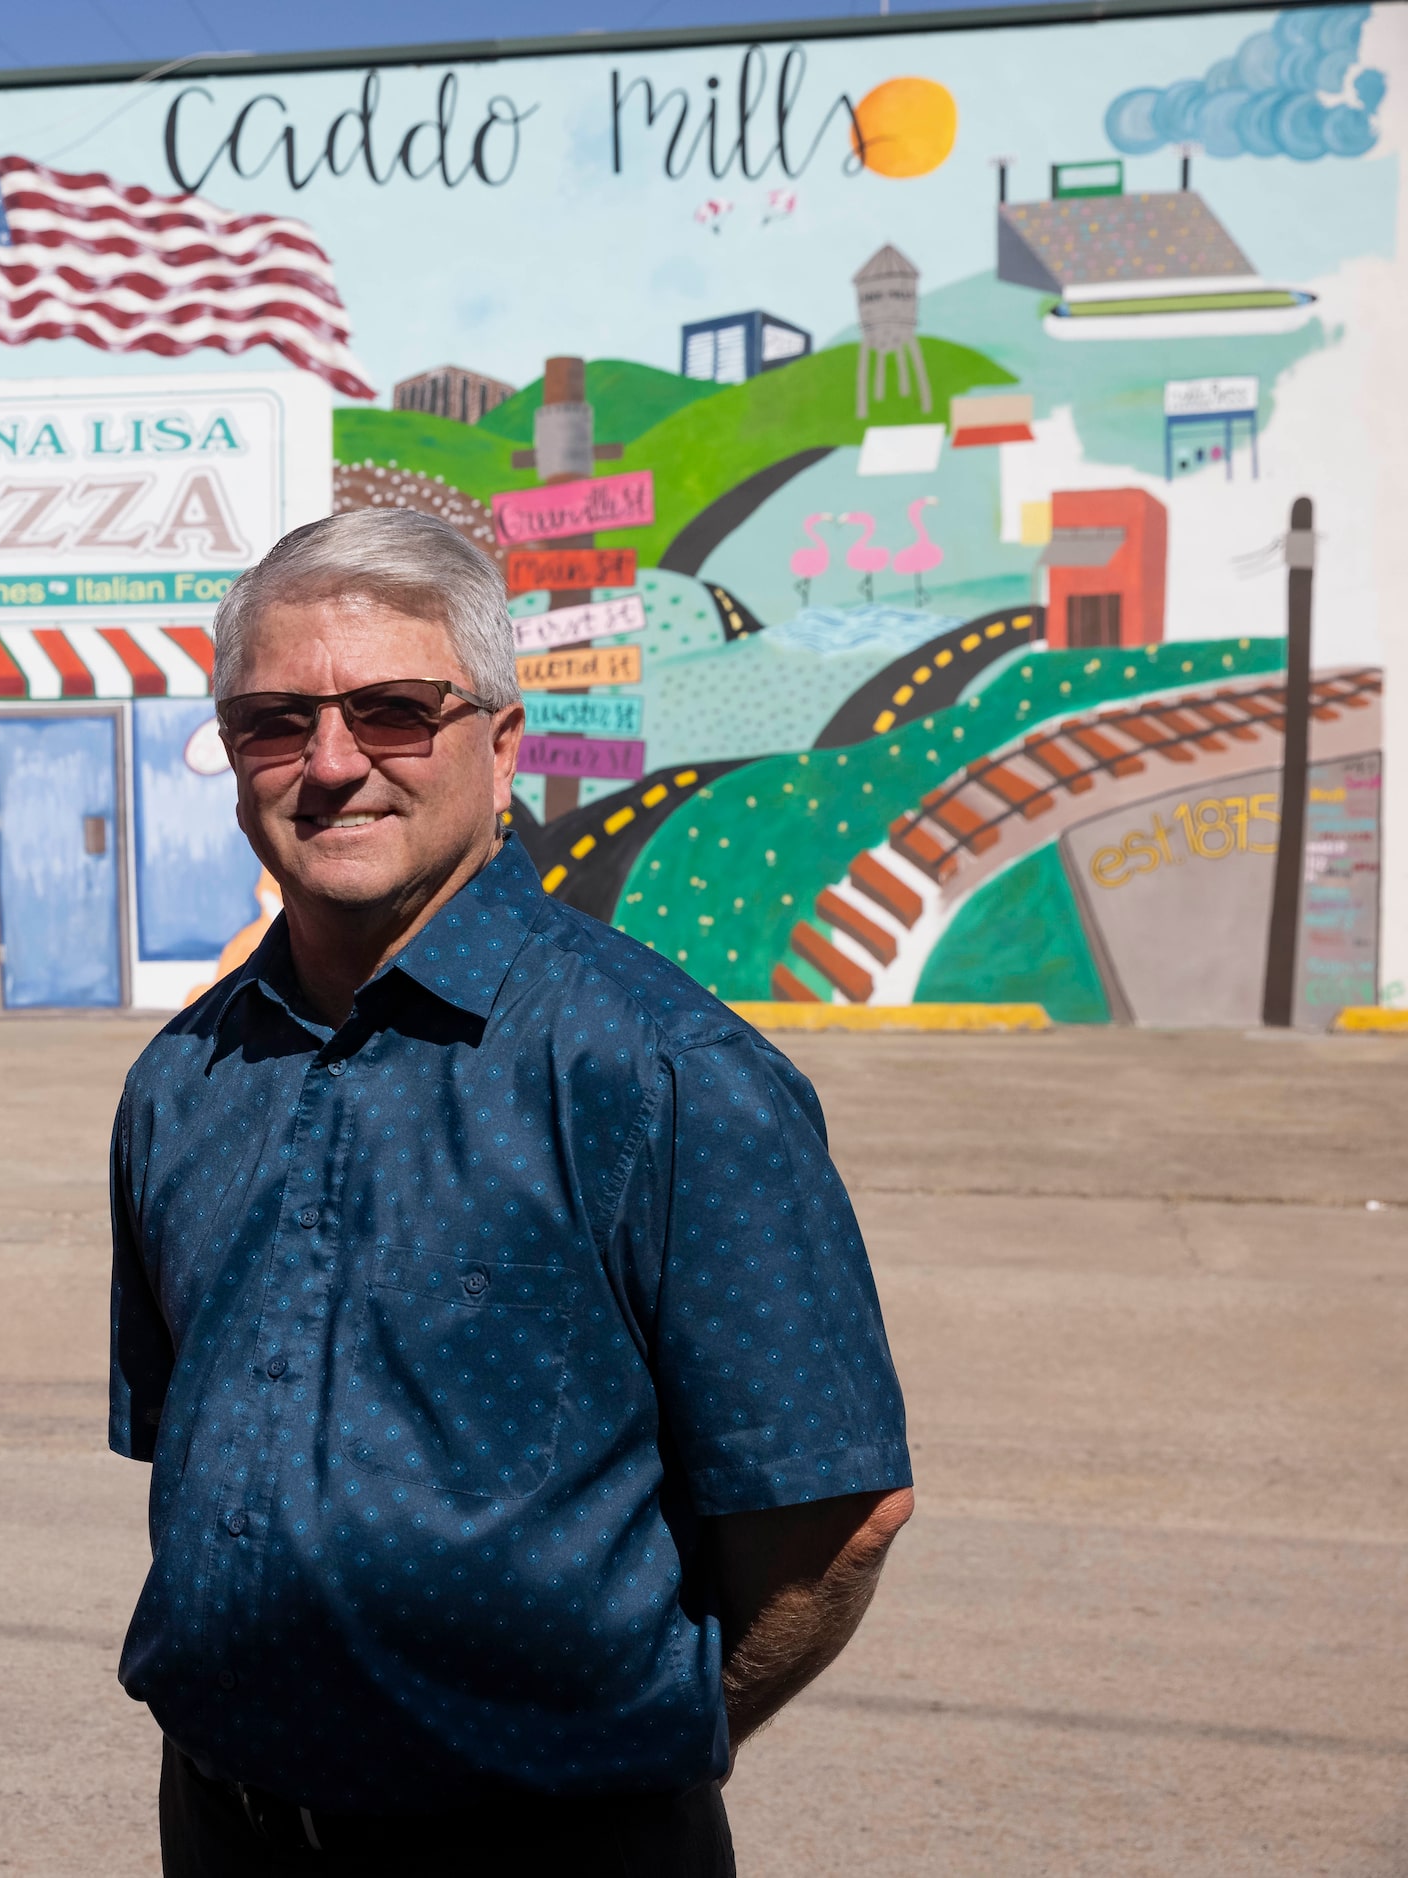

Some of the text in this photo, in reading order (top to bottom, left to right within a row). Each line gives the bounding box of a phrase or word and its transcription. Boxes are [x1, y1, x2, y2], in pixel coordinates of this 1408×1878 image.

[92, 416, 241, 455] LISA
[76, 575, 166, 603] Italian
[175, 573, 232, 601] Foo
[1173, 793, 1281, 859] 1875
